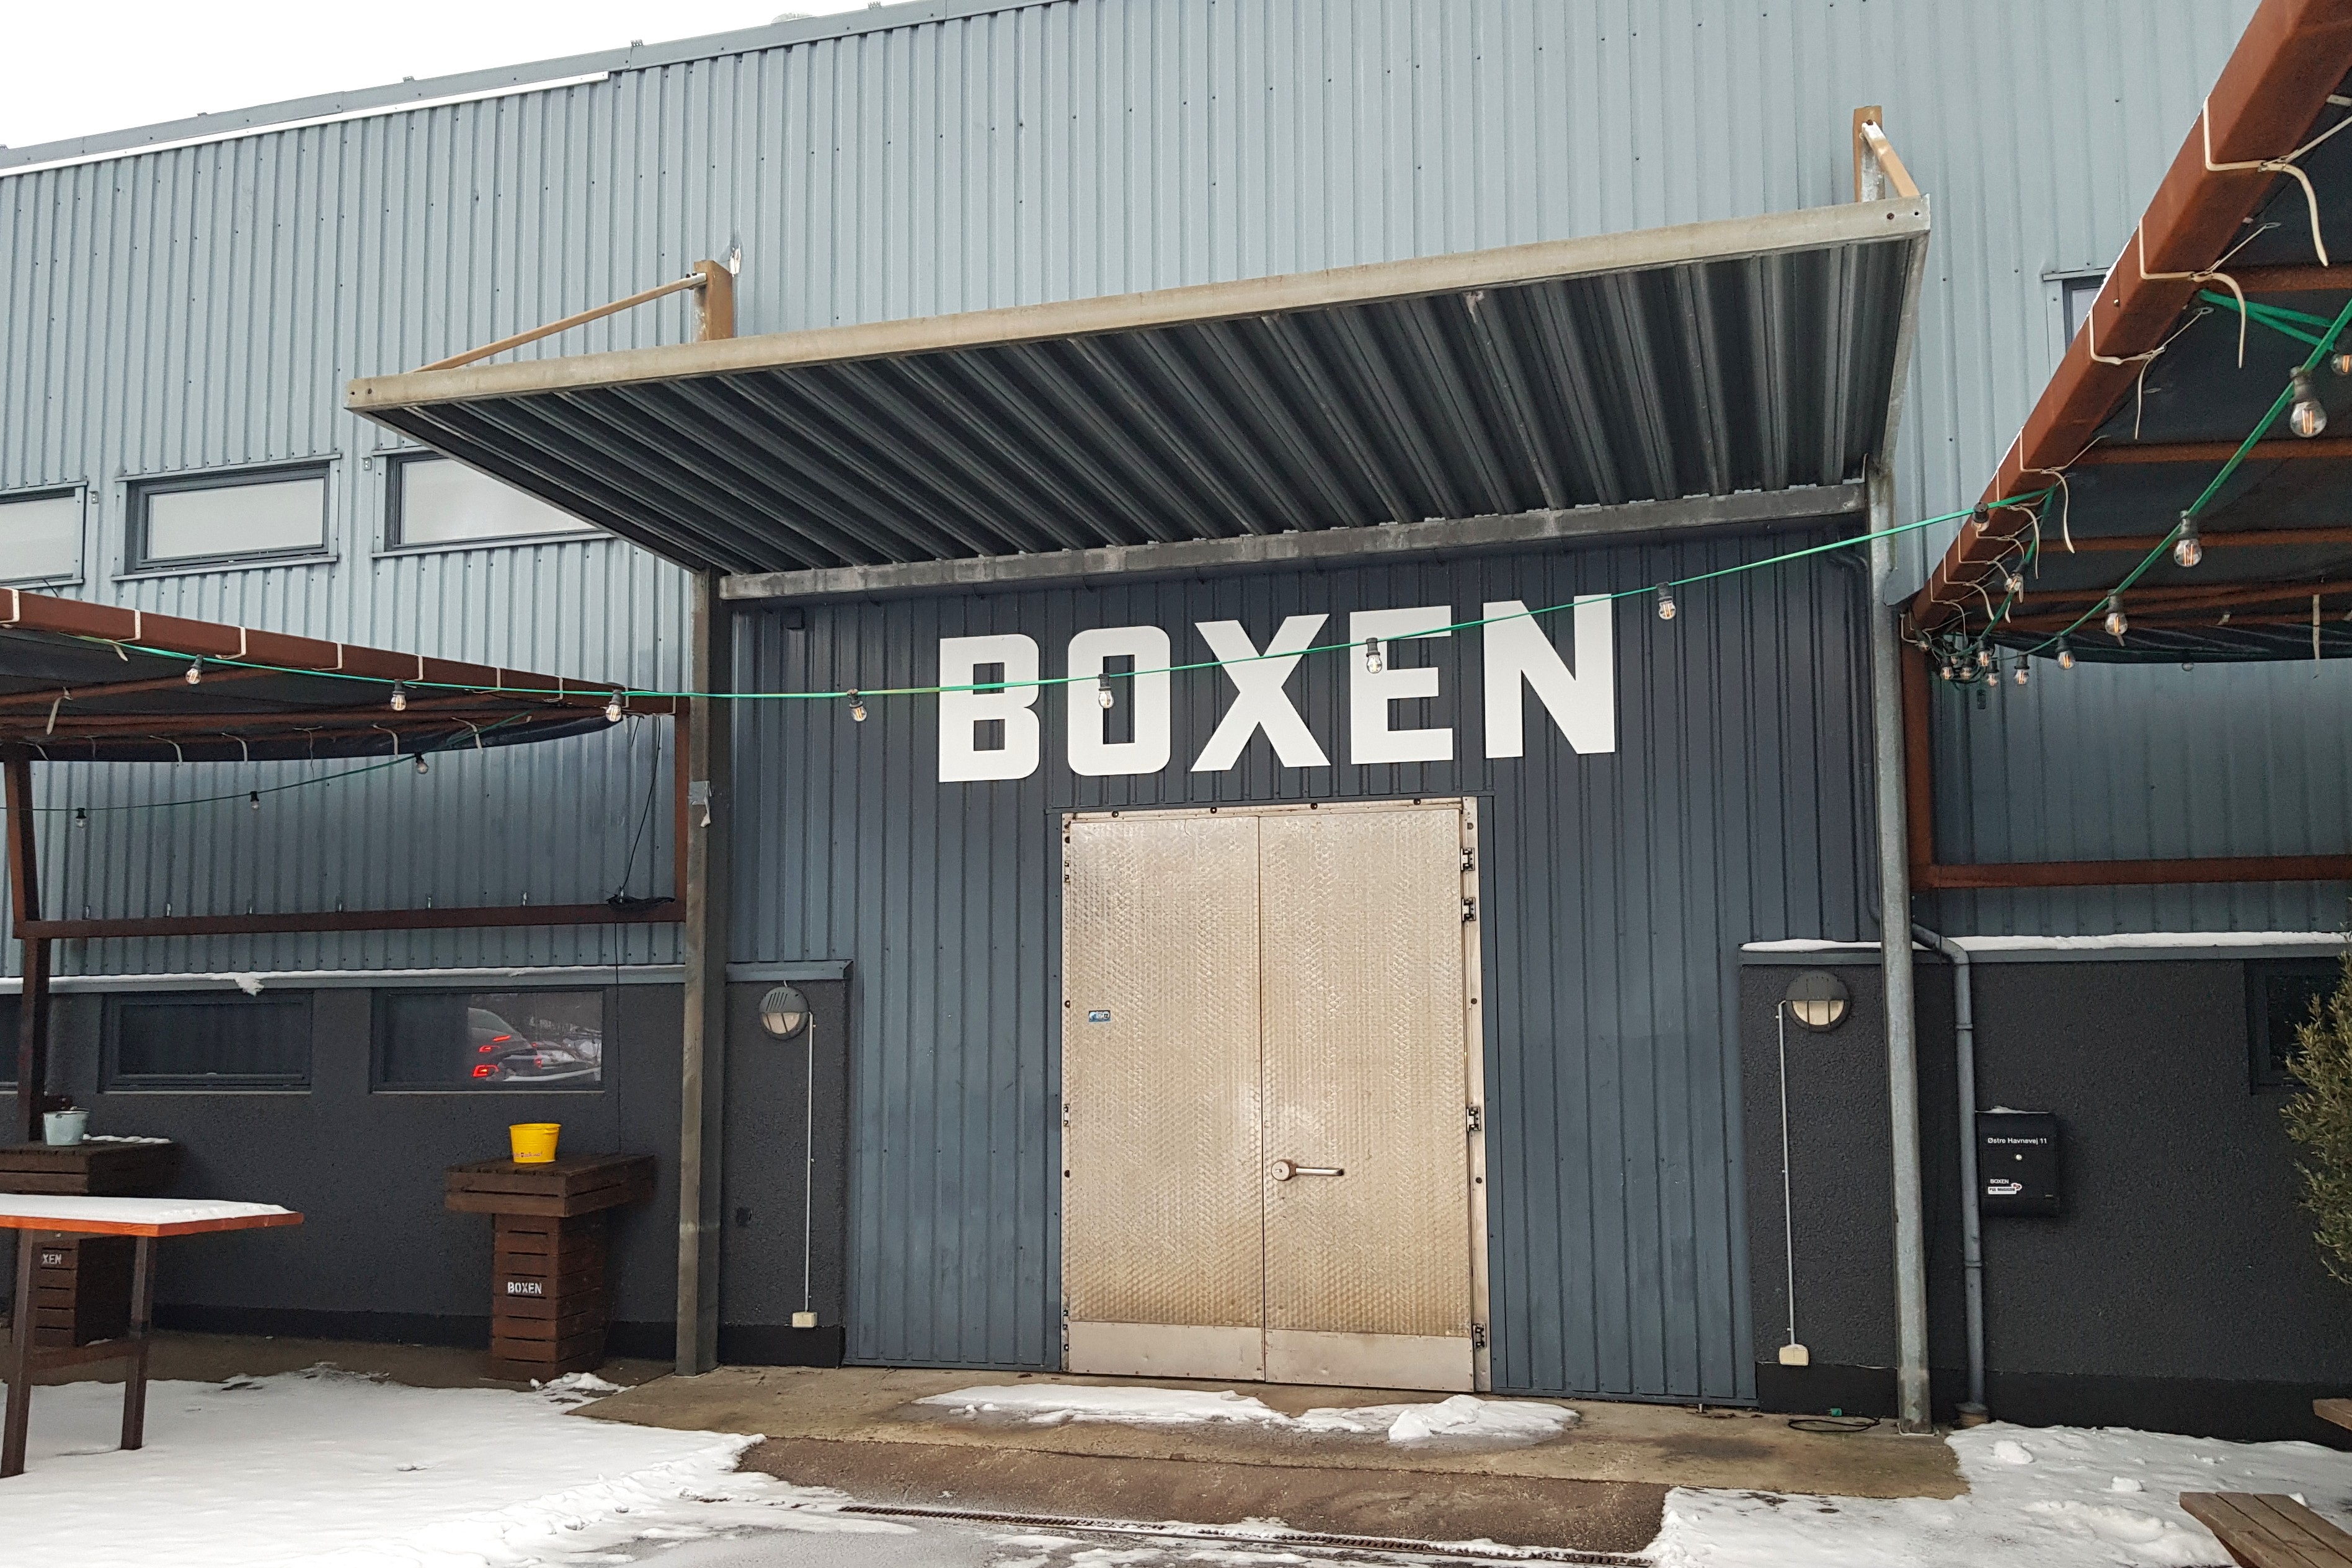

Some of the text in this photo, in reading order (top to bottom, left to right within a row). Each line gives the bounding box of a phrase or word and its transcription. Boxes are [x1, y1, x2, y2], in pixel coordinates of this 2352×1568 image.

[939, 594, 1615, 782] BOXEN
[42, 1253, 62, 1265] XEN
[507, 1282, 543, 1294] BOXEN
